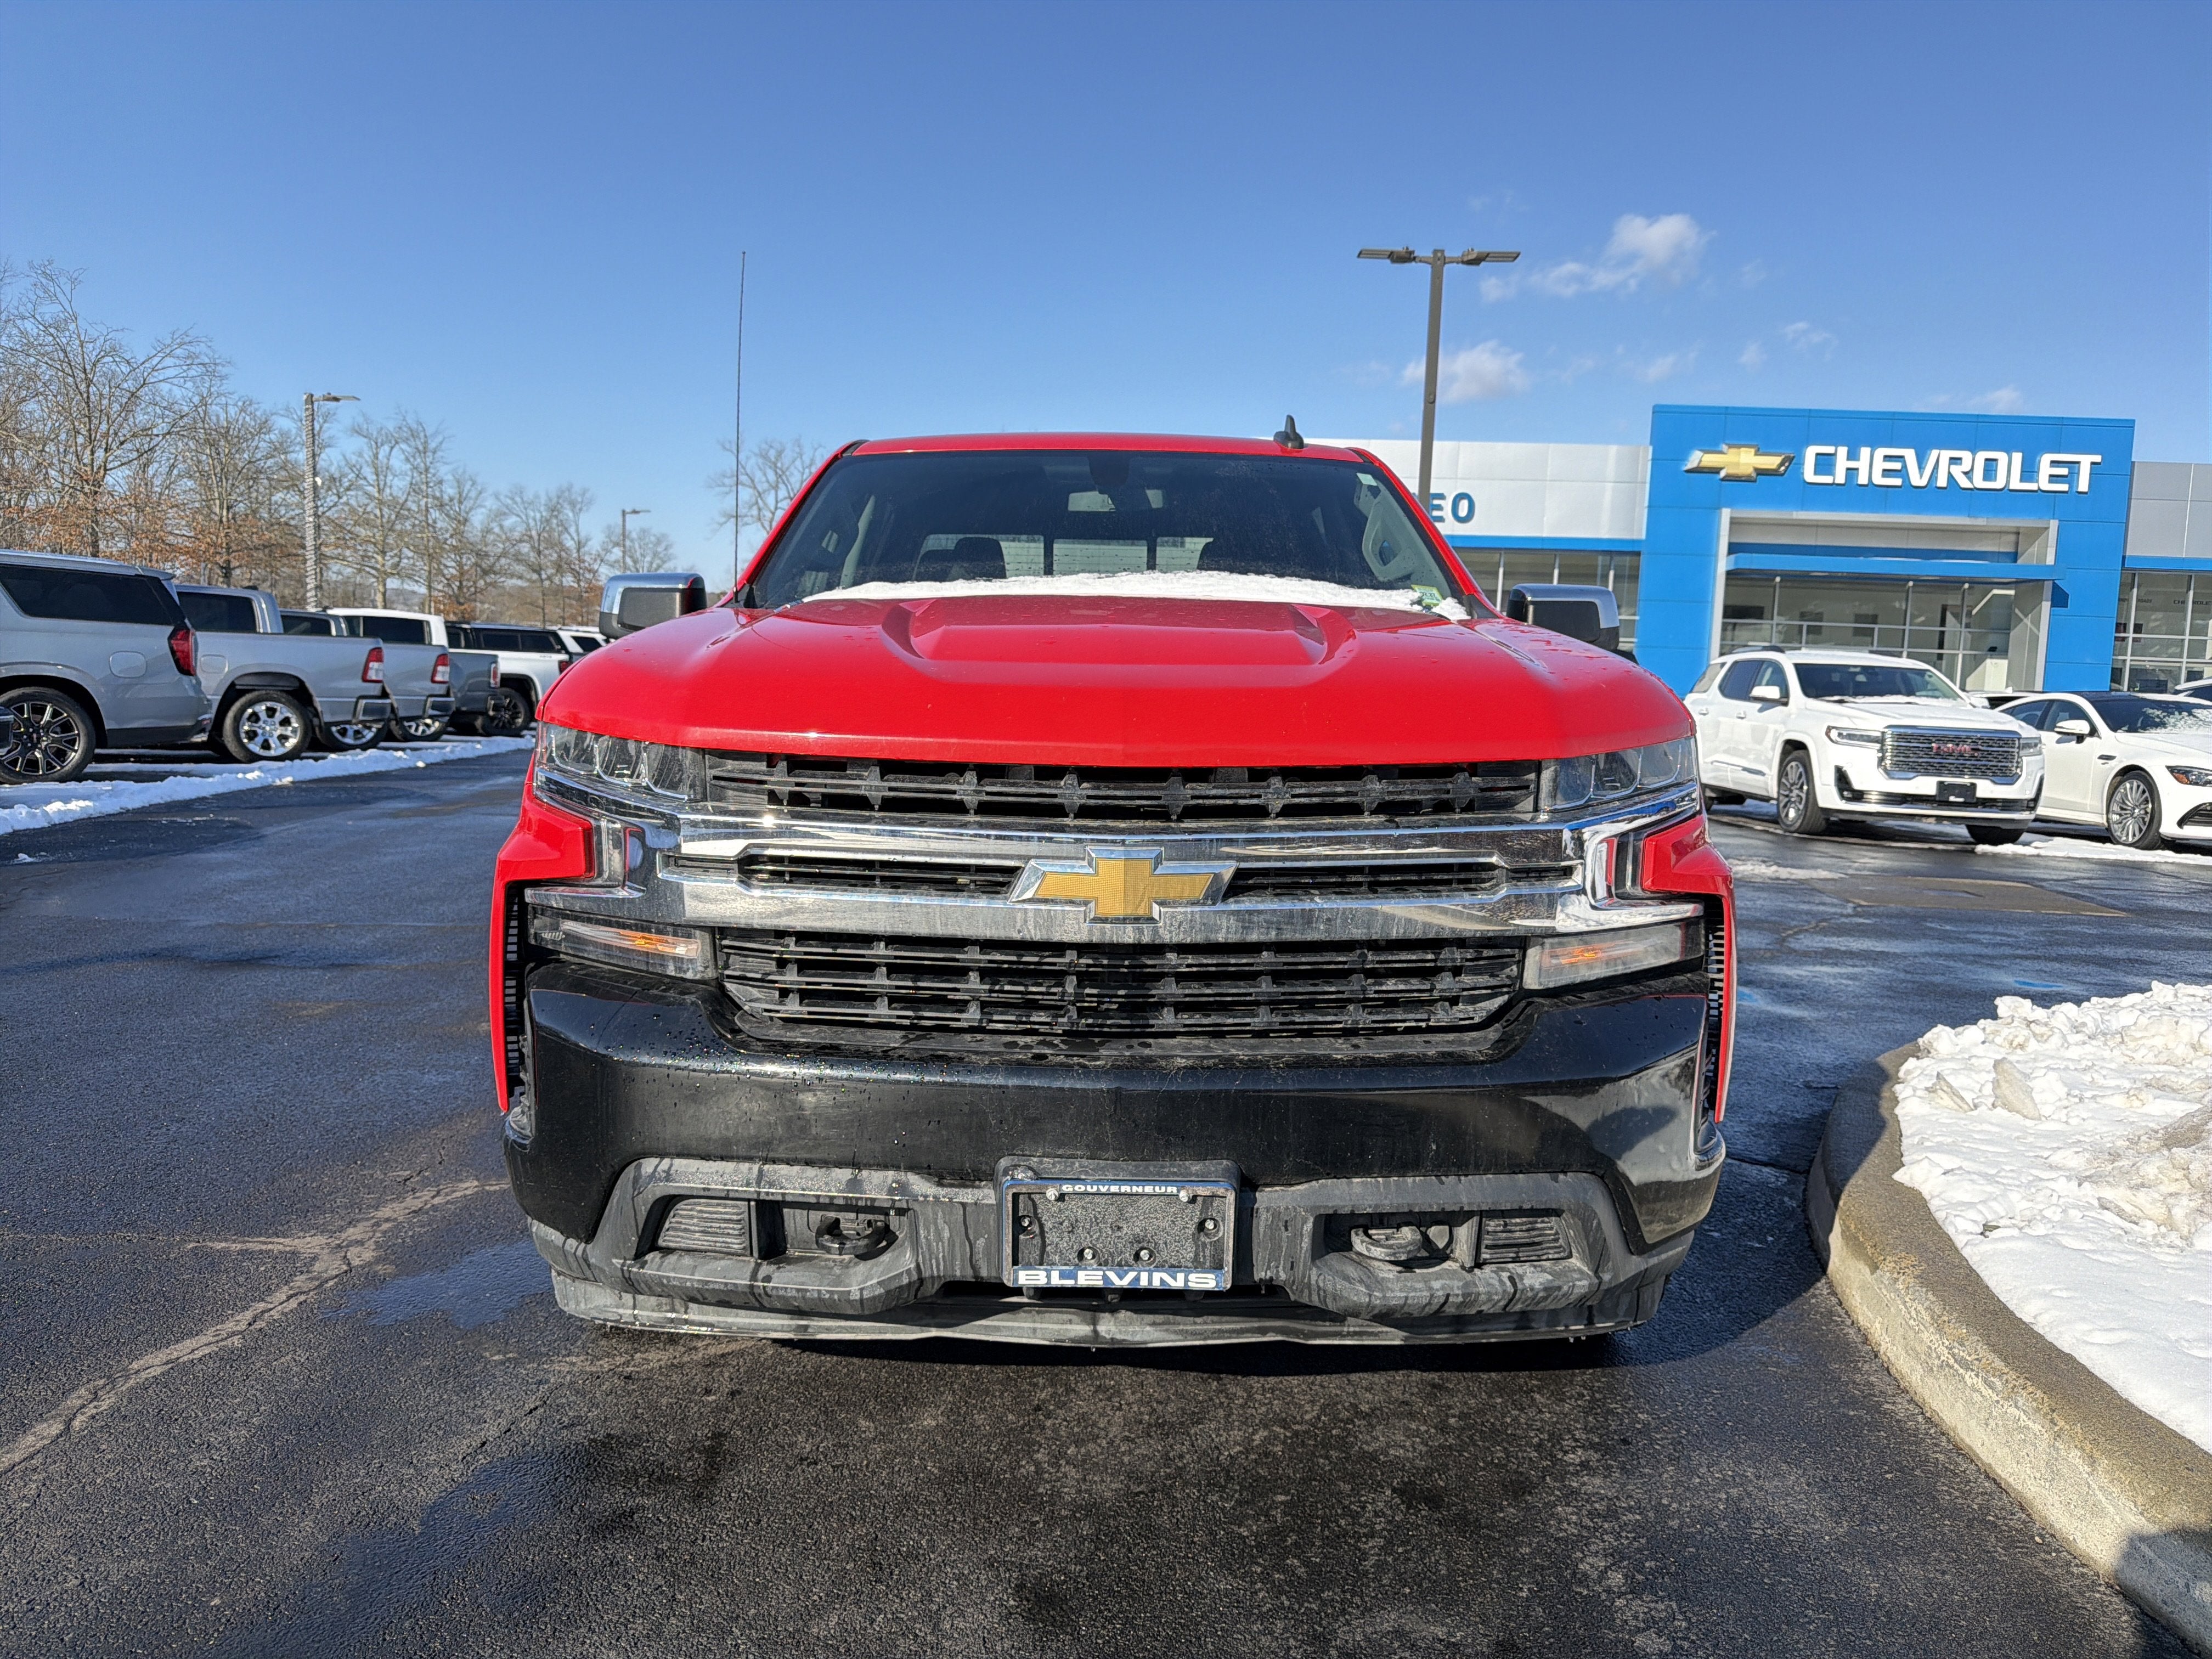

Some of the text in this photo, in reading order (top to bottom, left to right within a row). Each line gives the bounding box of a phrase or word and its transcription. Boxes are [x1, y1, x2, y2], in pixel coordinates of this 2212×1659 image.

[1803, 445, 2102, 494] CHEVROLET
[1062, 1184, 1178, 1194] GOUVERNEUR
[1018, 1269, 1216, 1288] BLEVINS
